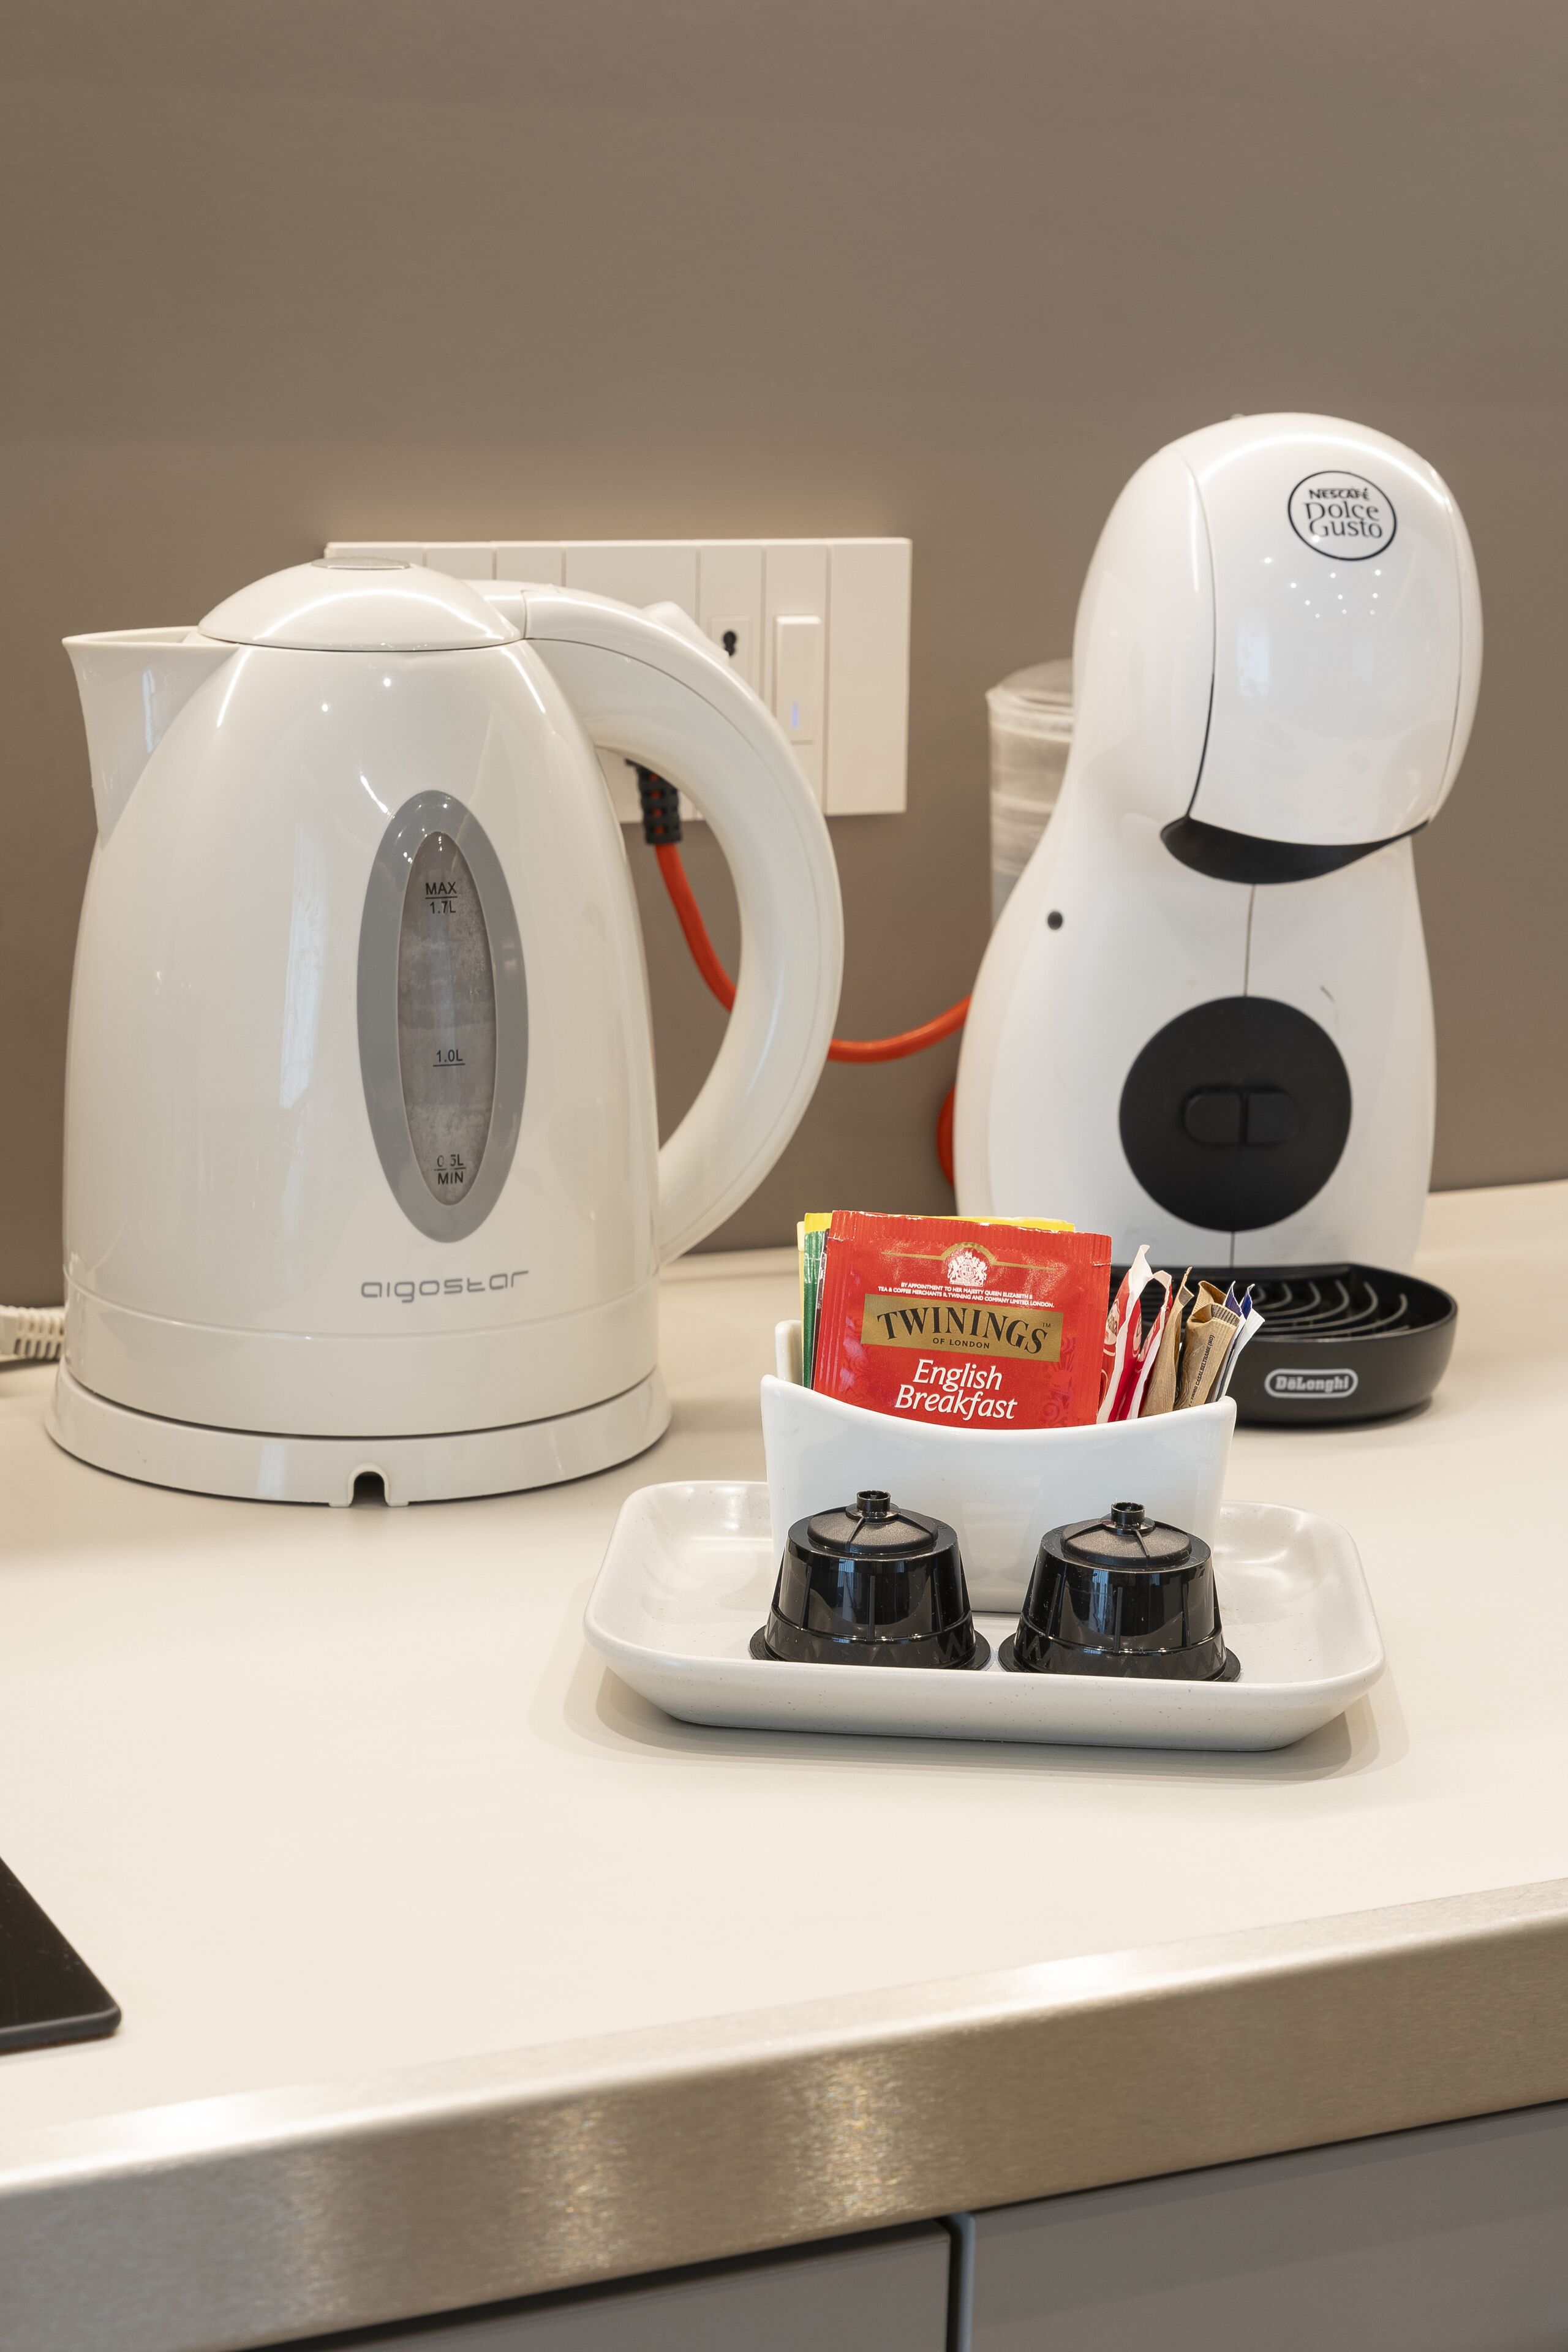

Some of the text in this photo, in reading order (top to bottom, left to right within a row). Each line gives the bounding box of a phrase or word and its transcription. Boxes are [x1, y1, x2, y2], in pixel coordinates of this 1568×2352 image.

[1304, 500, 1379, 521] Dolce
[1310, 519, 1382, 538] Gusto
[426, 881, 457, 895] MAX
[430, 900, 456, 914] 1.7L
[437, 1049, 463, 1063] 1.0L
[438, 1171, 463, 1185] MIN
[361, 1270, 529, 1303] aigostar
[912, 1289, 942, 1297] MERCHANTS
[877, 1306, 1048, 1354] TWININGS
[949, 1339, 990, 1349] LONDON
[913, 1359, 1002, 1392] English
[894, 1384, 1018, 1421] Breakfast
